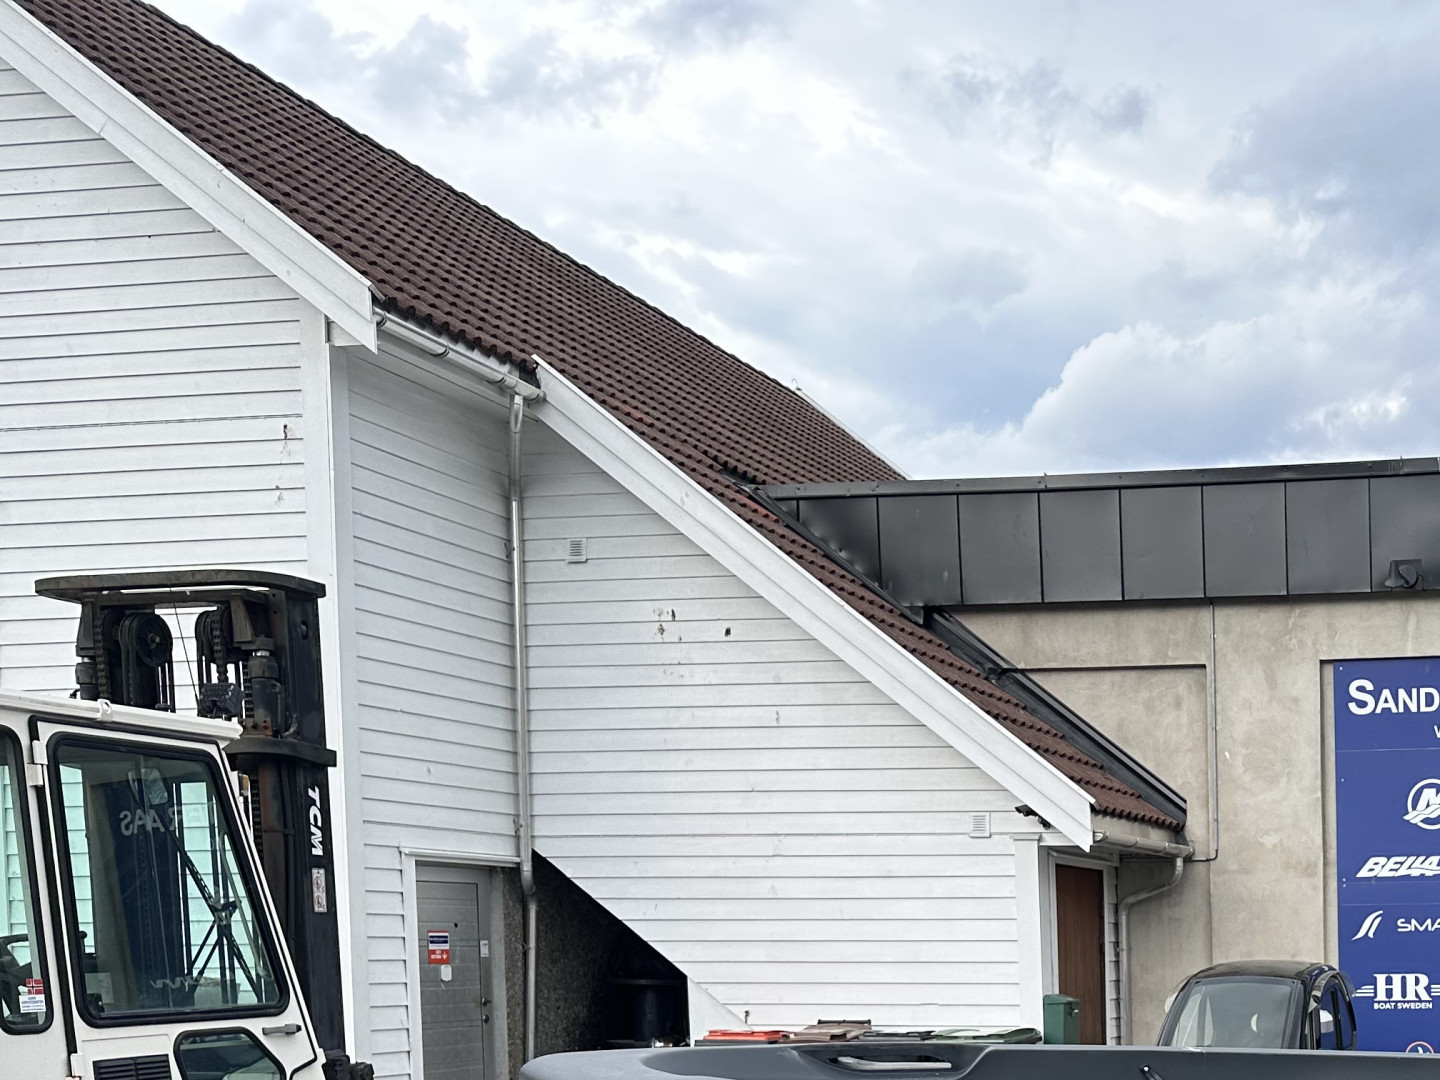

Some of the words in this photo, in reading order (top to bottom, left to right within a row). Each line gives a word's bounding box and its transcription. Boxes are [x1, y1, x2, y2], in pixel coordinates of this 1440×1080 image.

[1348, 678, 1440, 716] SAND
[308, 786, 323, 856] TCM
[1373, 973, 1433, 1001] HR
[1373, 1002, 1396, 1010] BOAT
[1397, 1002, 1433, 1010] SWEDEN
